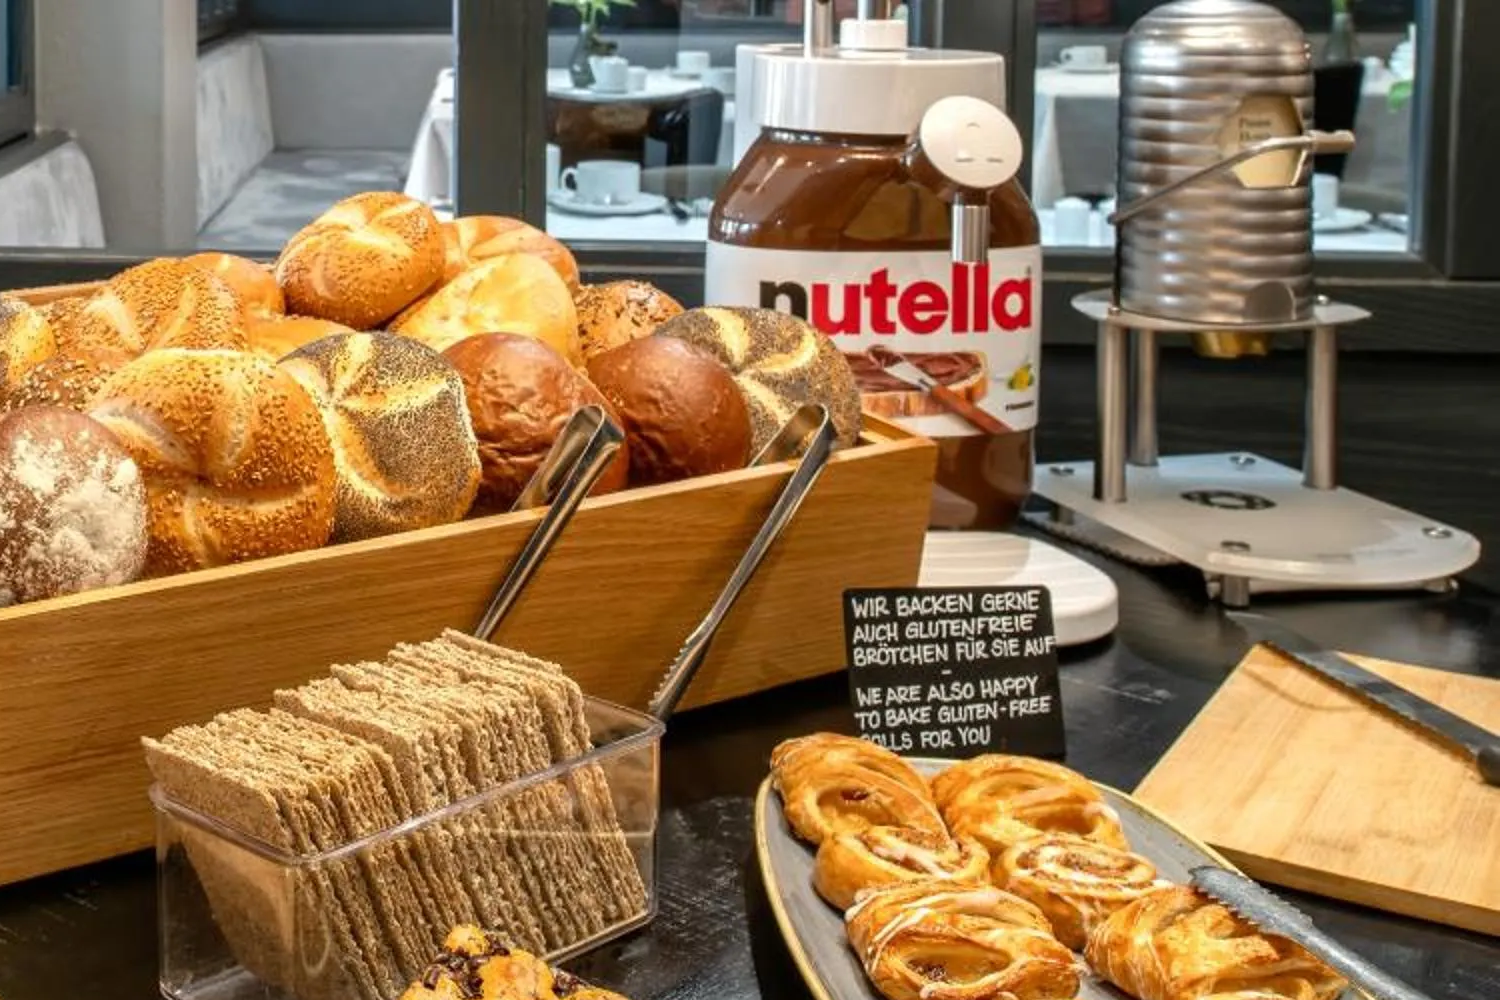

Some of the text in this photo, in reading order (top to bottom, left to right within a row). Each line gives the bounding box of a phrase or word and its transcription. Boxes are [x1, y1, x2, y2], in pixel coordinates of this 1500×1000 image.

[760, 262, 1031, 335] nutella
[852, 590, 1041, 618] WIR BACKEN GERNE
[853, 613, 1037, 645] AUCH GLUTENFREIE
[853, 642, 949, 667] BRÖTCHEN
[955, 637, 989, 661] FÜR
[1024, 636, 1057, 656] AUF
[856, 674, 1039, 706] WE ARE ALSO HAPPY
[854, 710, 881, 730] TO
[885, 706, 932, 727] BAKE
[920, 730, 955, 748] FOR
[957, 725, 991, 746] YOU
